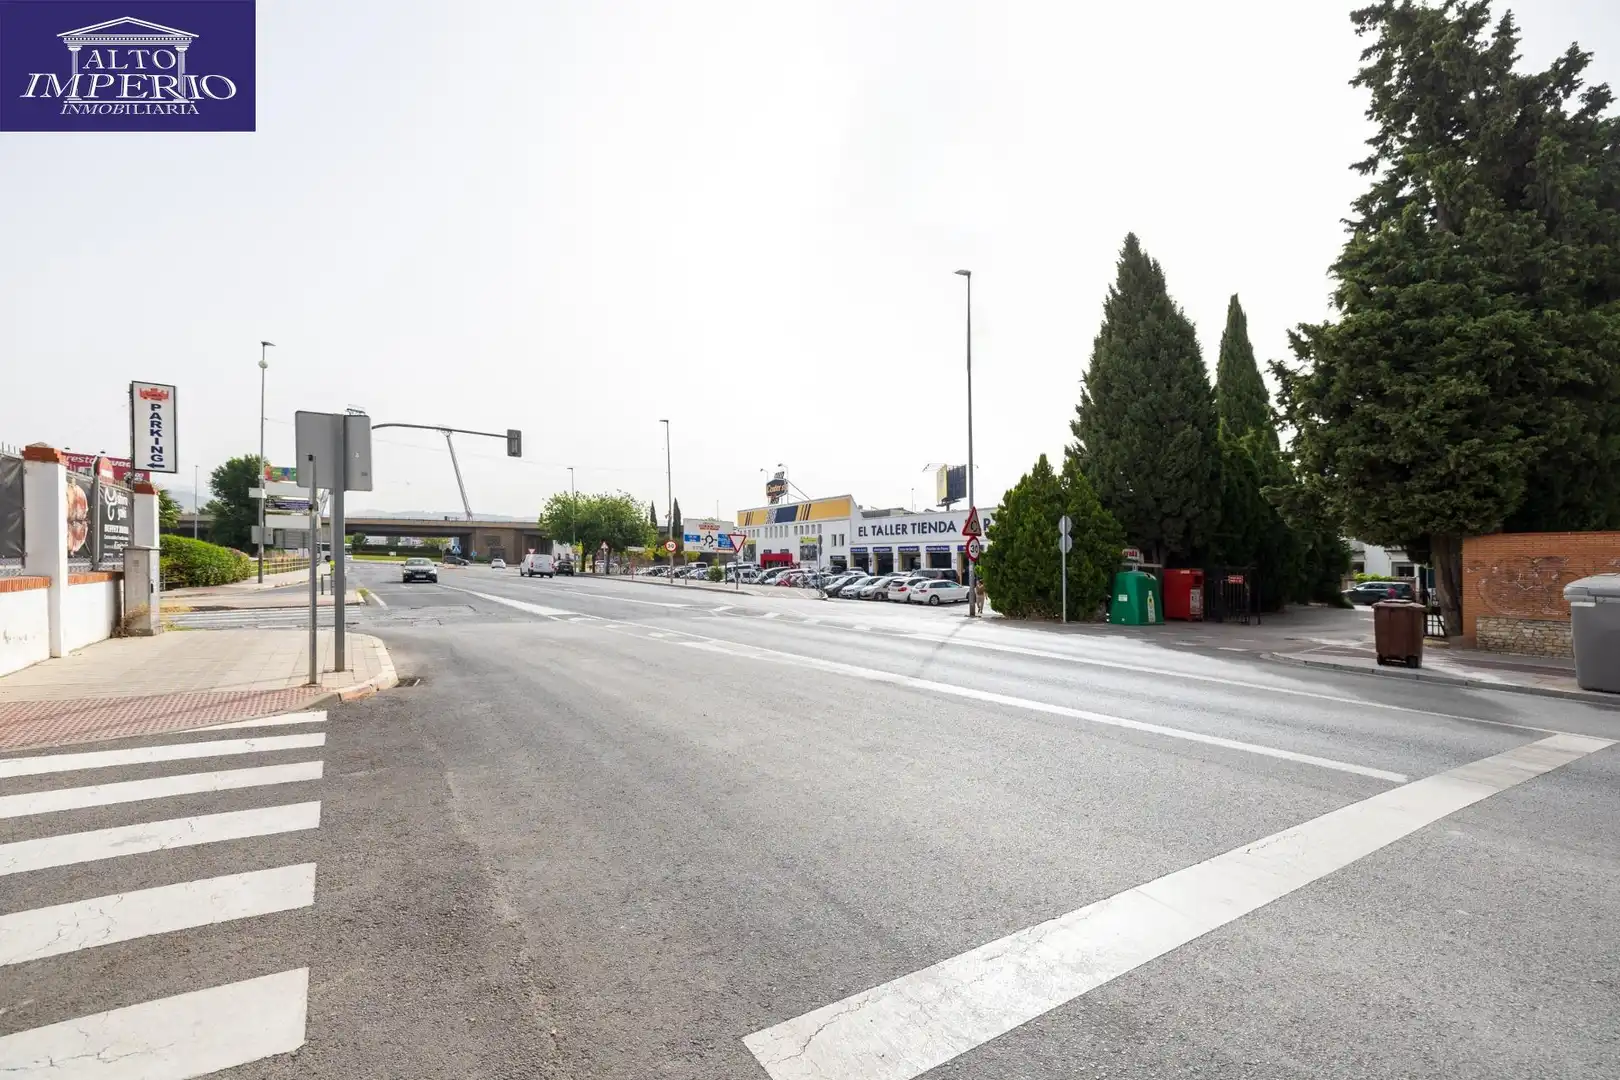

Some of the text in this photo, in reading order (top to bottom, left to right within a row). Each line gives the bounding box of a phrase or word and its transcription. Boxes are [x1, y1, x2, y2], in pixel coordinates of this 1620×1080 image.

[149, 403, 164, 463] PARKING
[858, 520, 957, 537] EL TALLER TIENDA
